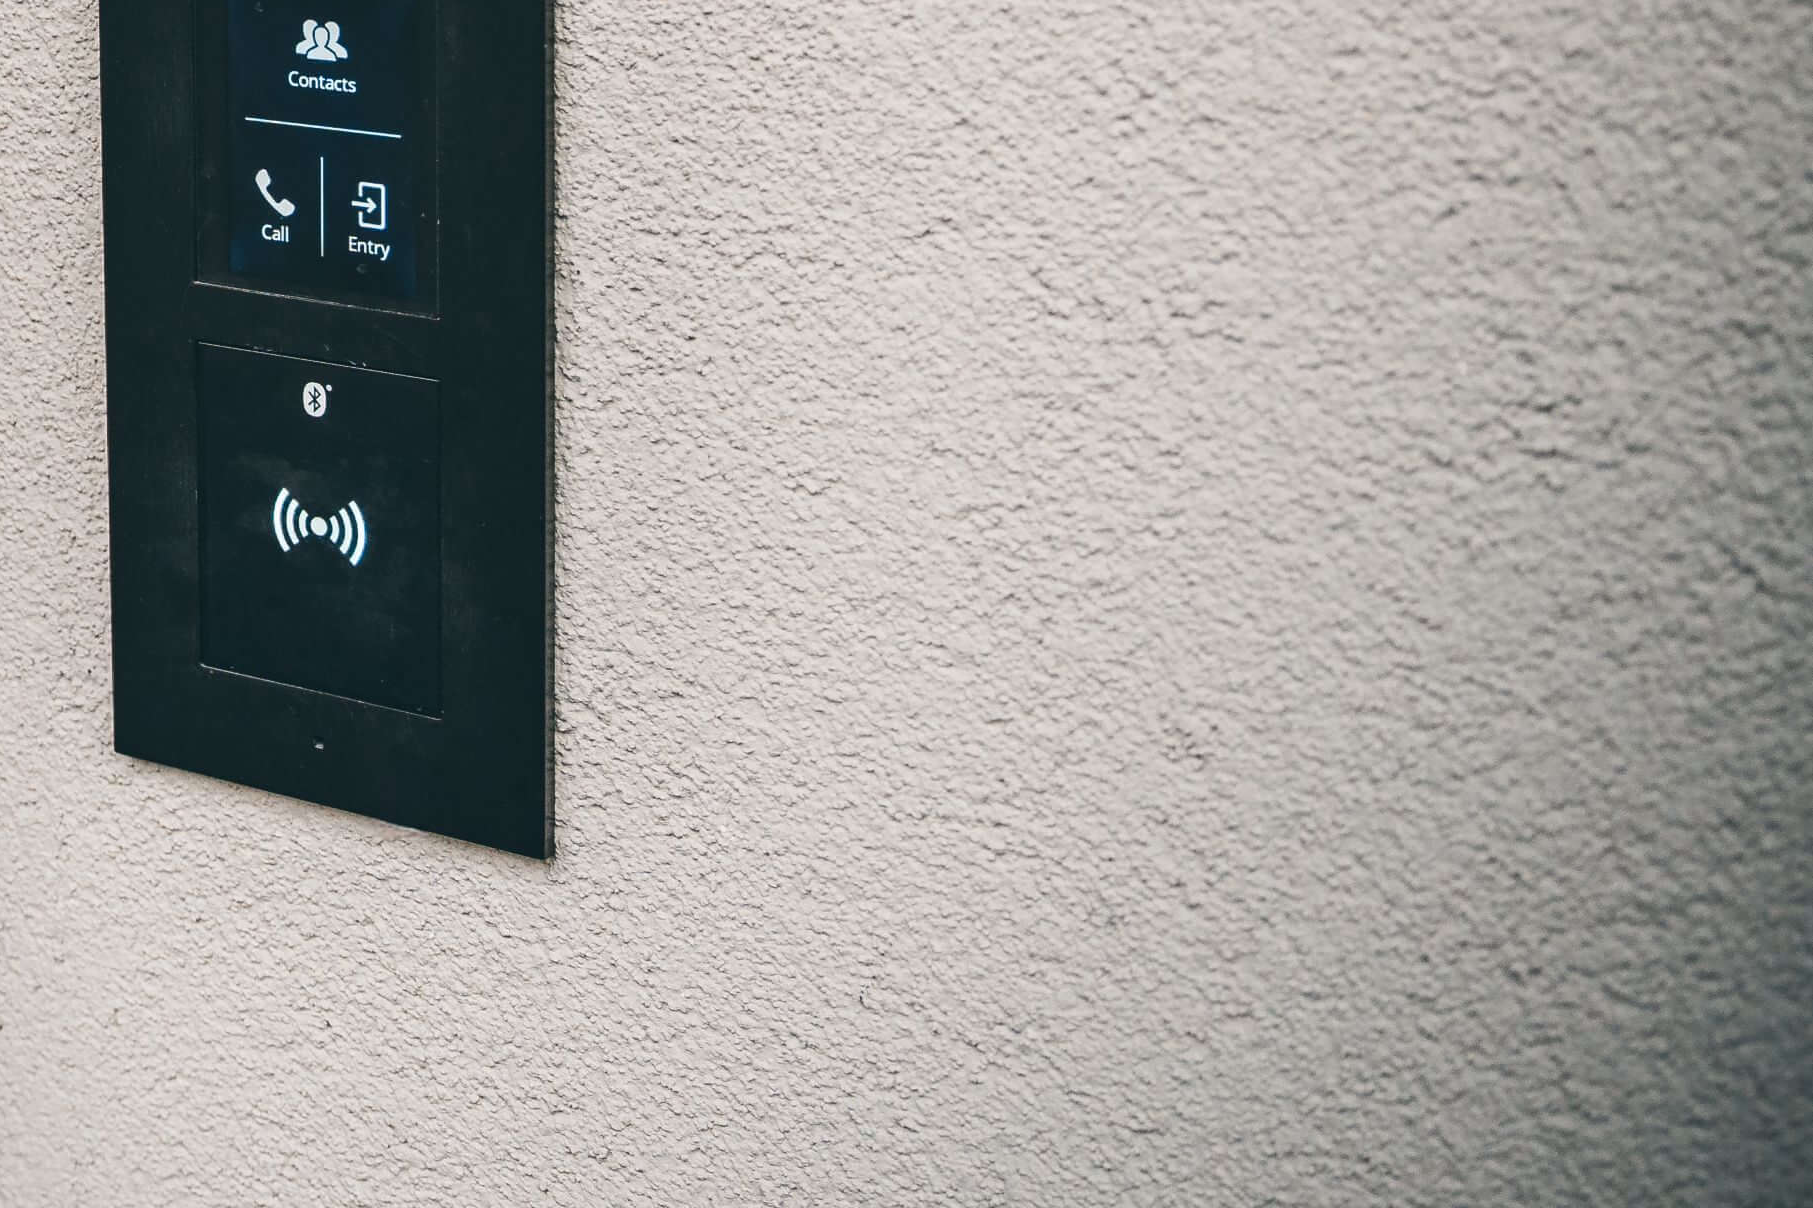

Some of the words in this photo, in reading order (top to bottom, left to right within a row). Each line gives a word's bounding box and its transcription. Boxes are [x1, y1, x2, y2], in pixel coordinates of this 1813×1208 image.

[287, 70, 357, 94] Contacts
[261, 224, 290, 243] Call
[348, 236, 391, 261] Entry
